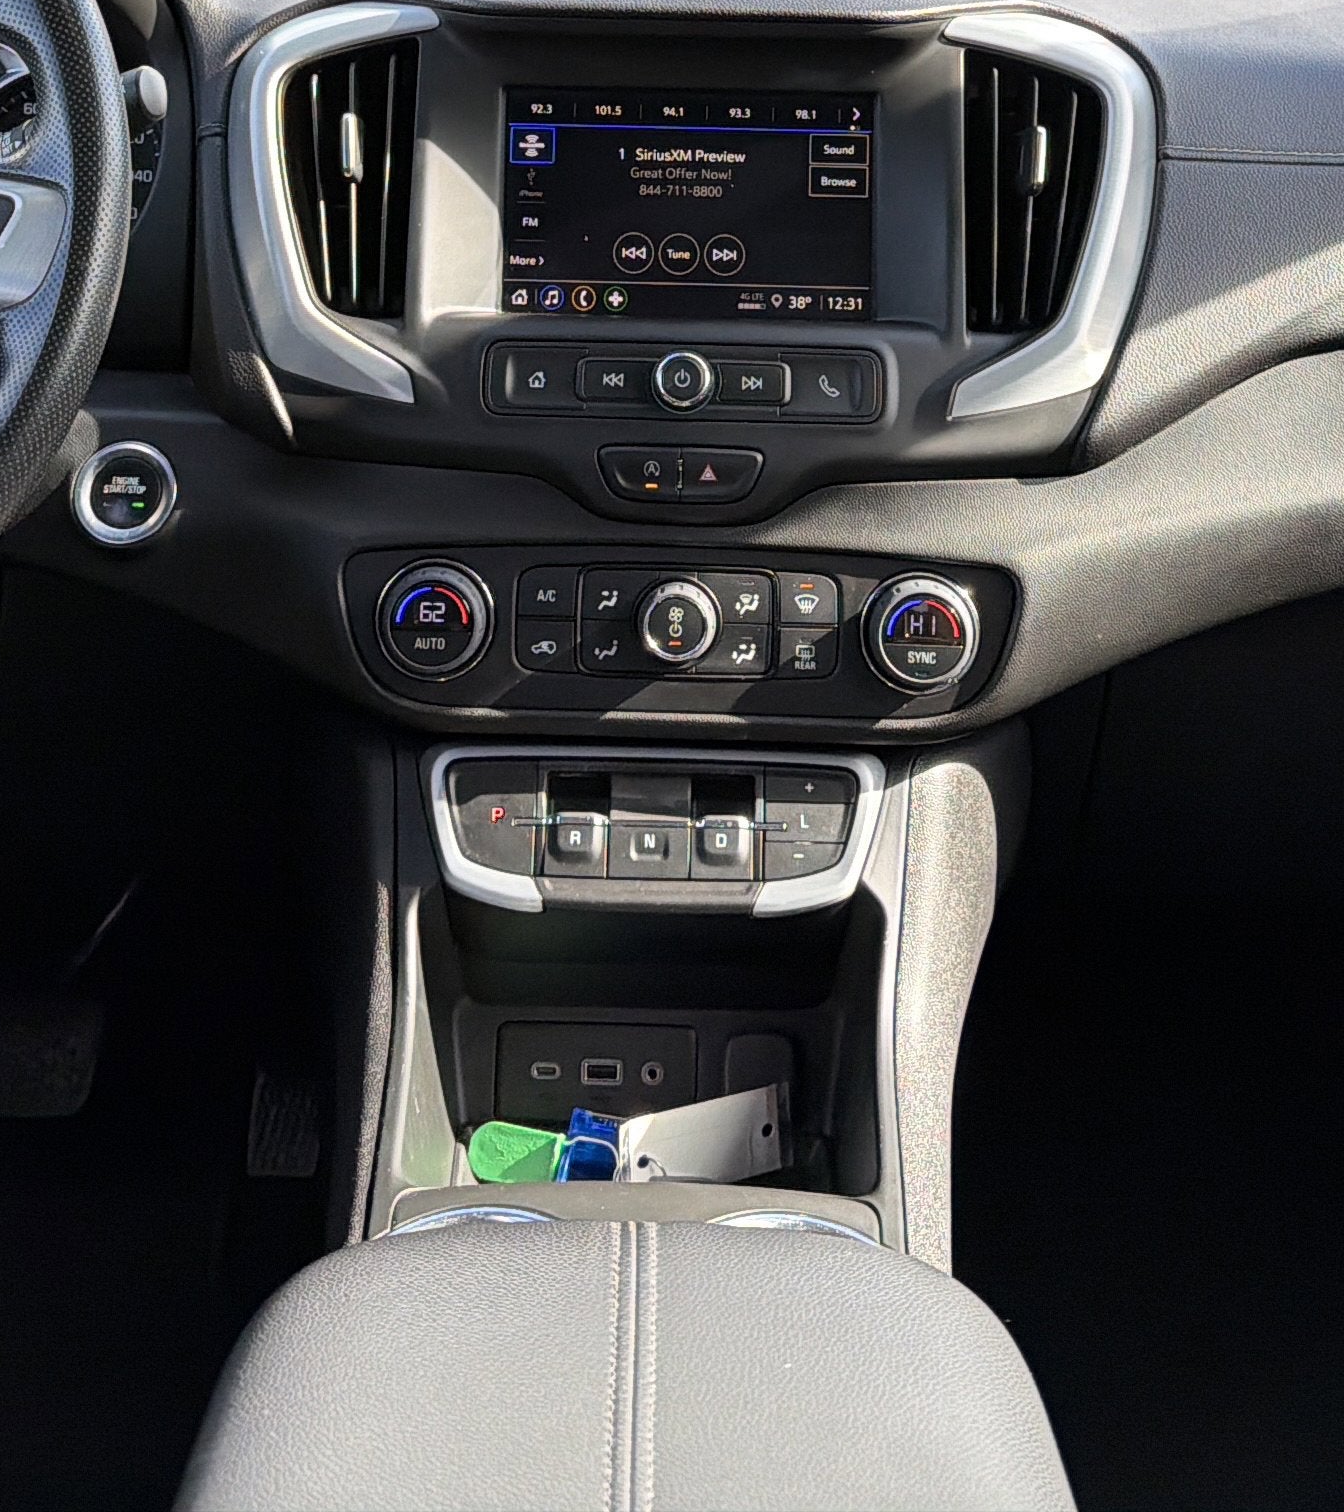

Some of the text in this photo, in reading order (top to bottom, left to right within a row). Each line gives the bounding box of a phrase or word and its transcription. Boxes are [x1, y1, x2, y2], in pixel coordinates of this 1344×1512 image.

[531, 103, 817, 120] 92.3 101.5 94.1 93.3 98.1
[618, 148, 746, 164] 1 SiriusXM Preview
[823, 144, 855, 156] Sound
[630, 167, 732, 181] Great Offer Now!
[820, 176, 857, 187] Browse
[639, 185, 722, 198] 844-711-8800
[522, 217, 538, 228] FM
[510, 255, 536, 266] More
[667, 249, 691, 260] Tune
[828, 297, 863, 310] 12:31
[112, 476, 140, 485] ENGINE
[103, 484, 146, 494] START/STOP
[537, 589, 556, 602] A/C
[420, 602, 446, 623] 62
[414, 637, 446, 650] AUTO
[907, 651, 937, 664] SYNC
[794, 661, 816, 670] REAR
[490, 807, 506, 823] P
[800, 814, 809, 829] L
[570, 830, 581, 846] R
[644, 833, 656, 848] N
[716, 834, 727, 848] D
